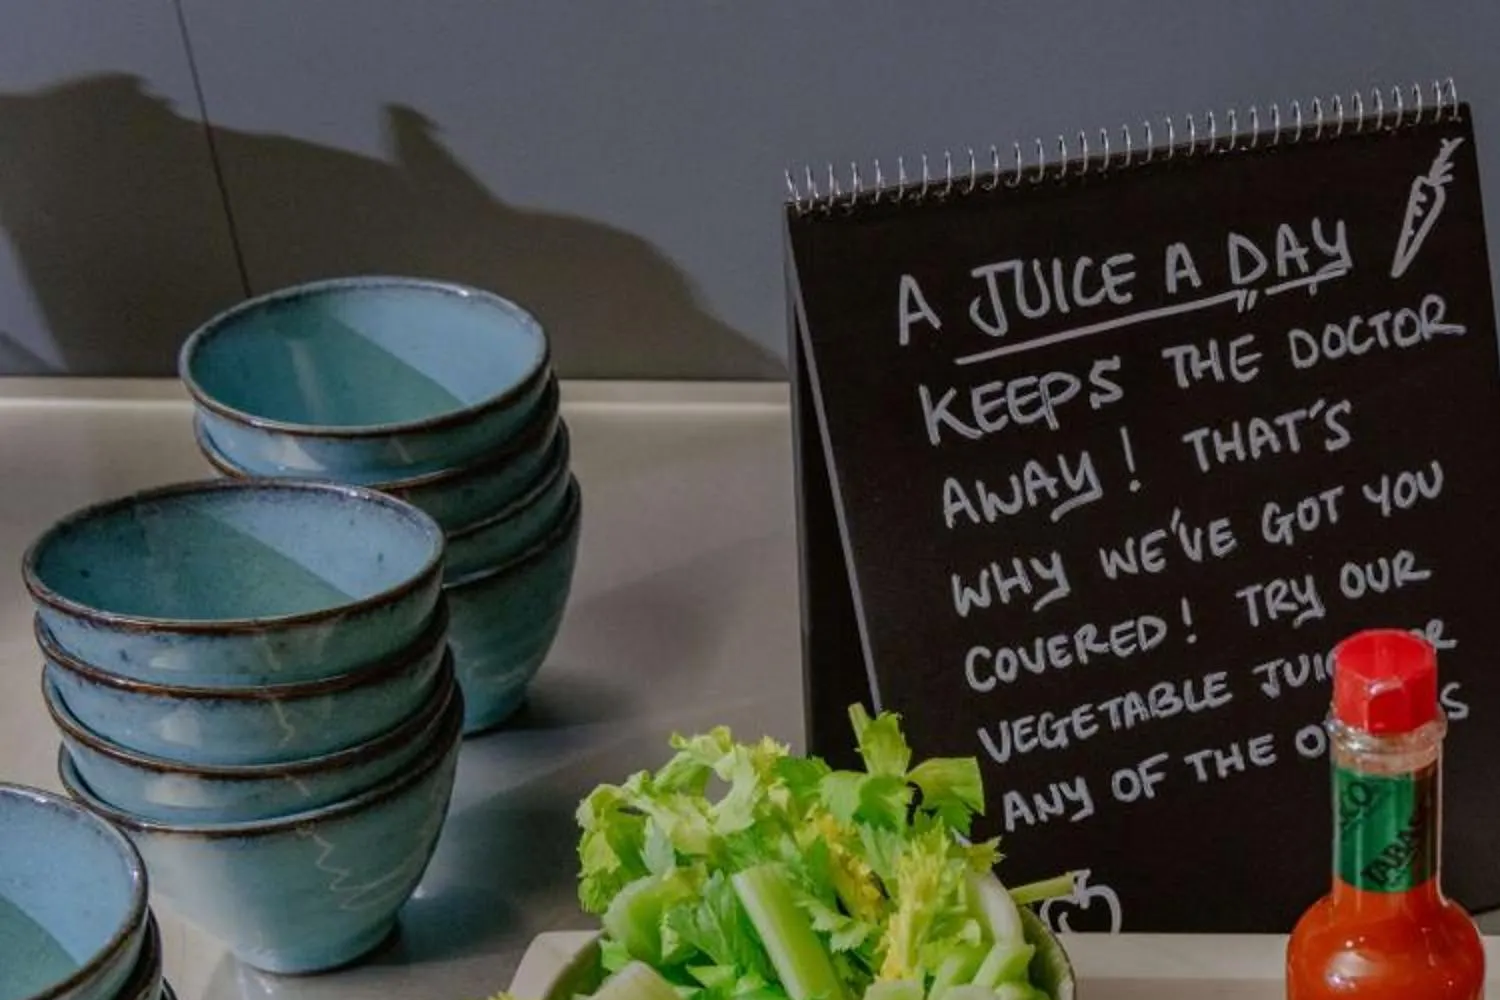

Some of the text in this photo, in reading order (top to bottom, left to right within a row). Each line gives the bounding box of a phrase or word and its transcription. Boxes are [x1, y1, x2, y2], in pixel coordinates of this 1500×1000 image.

[899, 217, 1348, 345] A JUICE A DAY
[918, 293, 1466, 446] KEEPS THE DOCTOR
[1184, 400, 1352, 472] THAT'S
[951, 460, 1445, 618] WHY WE'VE GOT YOU
[1236, 574, 1327, 628] TRY
[1339, 550, 1432, 599] OUR
[977, 671, 1234, 764] VEGETABLE
[1004, 733, 1278, 832] ANY OF THE
